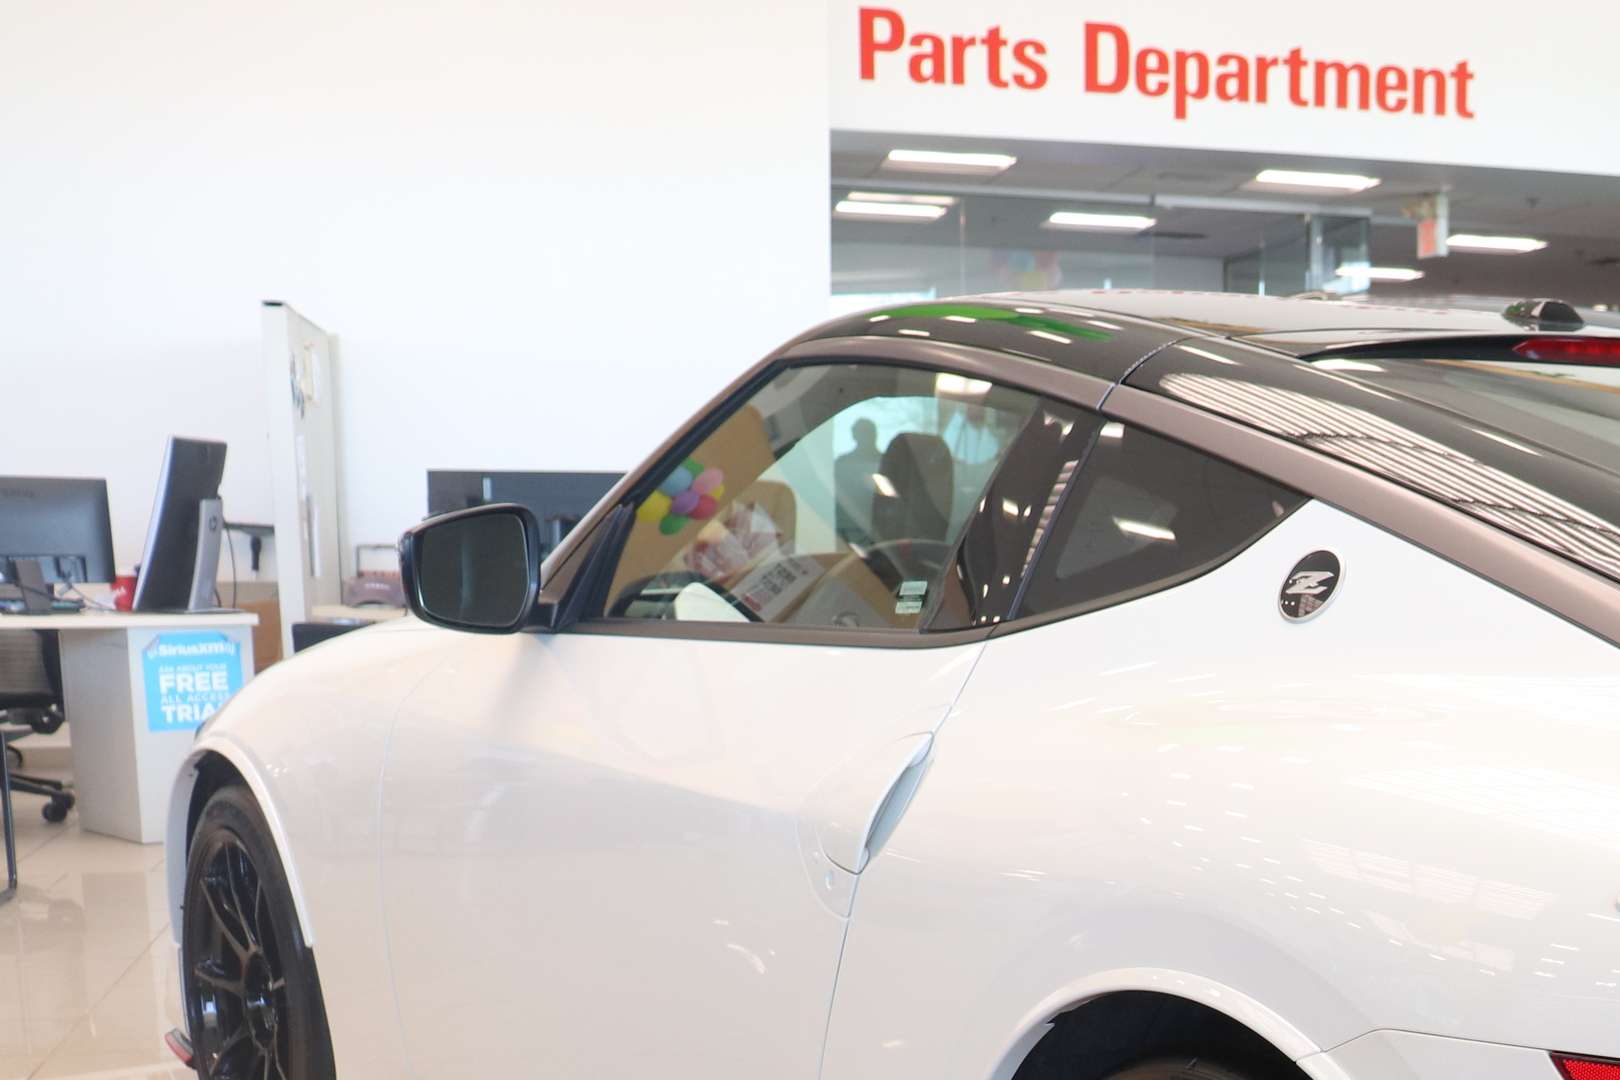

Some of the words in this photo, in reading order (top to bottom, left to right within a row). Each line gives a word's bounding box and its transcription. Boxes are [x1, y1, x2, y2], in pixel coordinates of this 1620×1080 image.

[859, 6, 1049, 90] Parts
[1084, 21, 1475, 119] Department
[159, 671, 229, 695] FREE
[161, 701, 223, 724] TRIA
